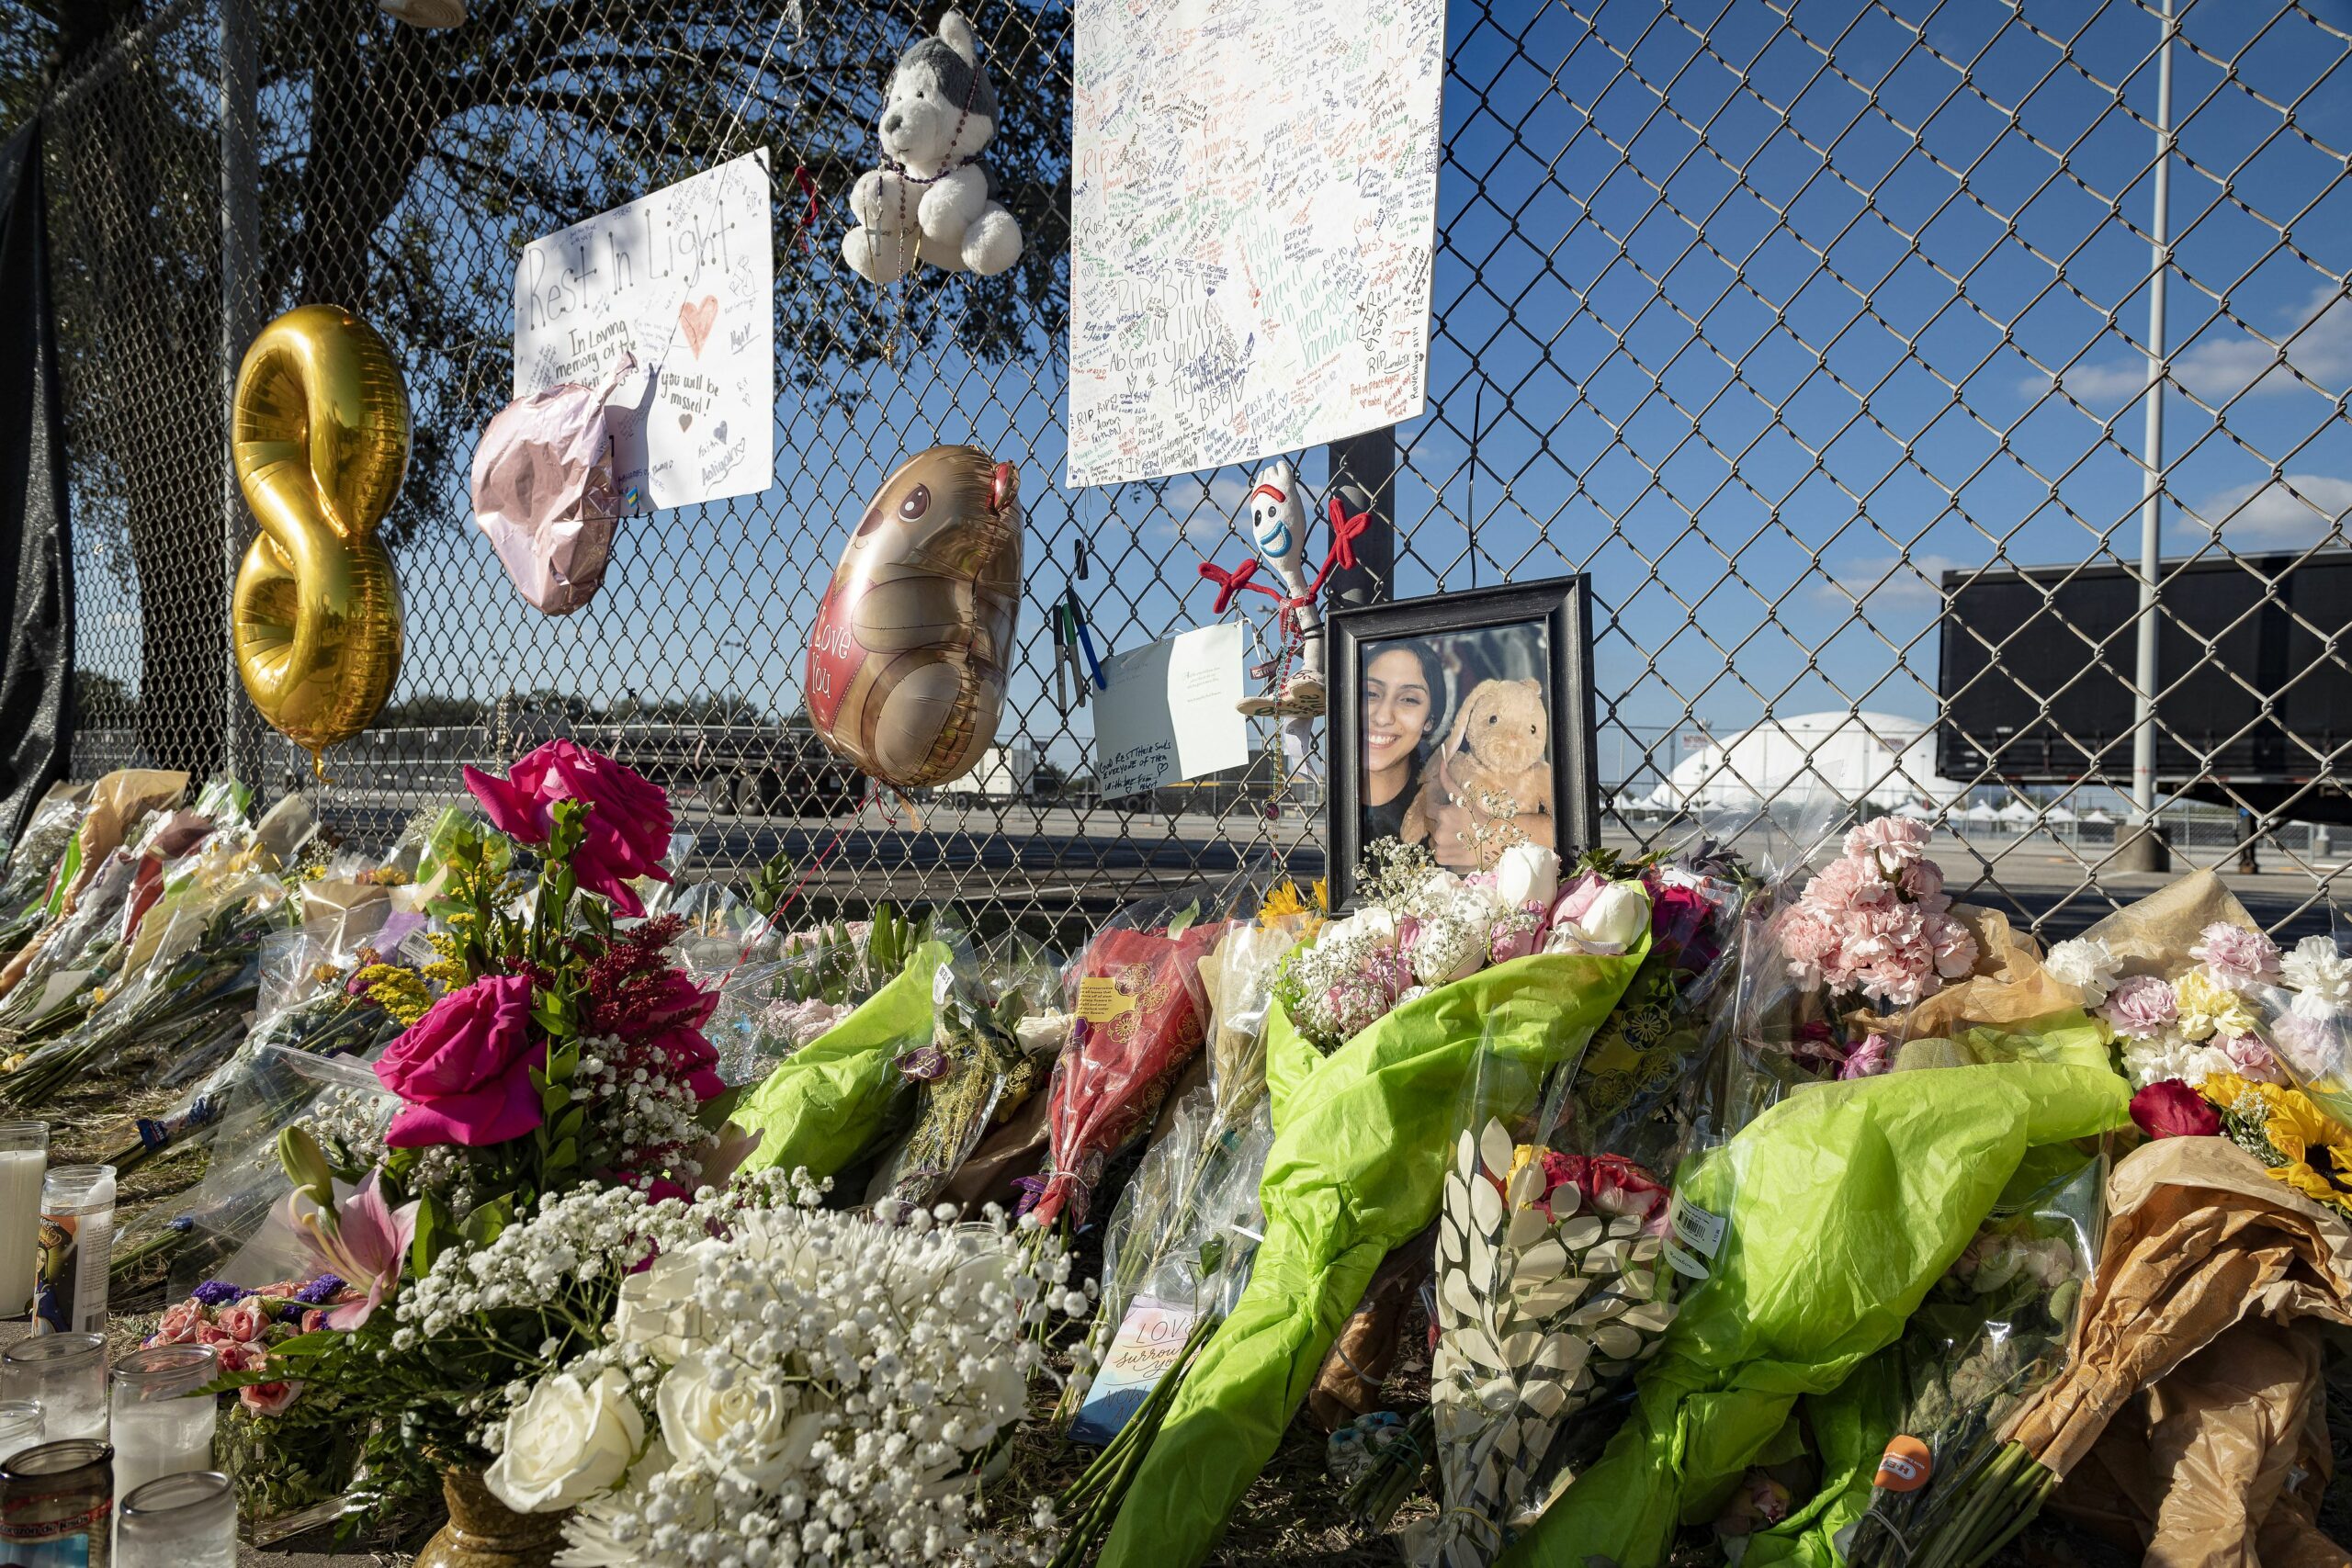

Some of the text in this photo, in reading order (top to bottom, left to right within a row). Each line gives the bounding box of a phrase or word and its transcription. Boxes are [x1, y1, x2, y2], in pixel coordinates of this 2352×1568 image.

[1083, 149, 1109, 178] RIP
[1354, 209, 1373, 234] God
[527, 199, 735, 332] Rest In Light
[1207, 265, 1228, 275] POWER
[569, 328, 585, 356] In
[589, 321, 629, 348] Loving
[556, 352, 600, 379] memory
[603, 342, 615, 360] of
[1367, 350, 1385, 376] RIP
[661, 373, 680, 398] you
[684, 375, 702, 389] will
[707, 378, 719, 396] be
[1245, 388, 1276, 419] Rest in
[1077, 409, 1093, 426] RIP
[812, 652, 831, 698] You
[1102, 1385, 1147, 1407] NOW
